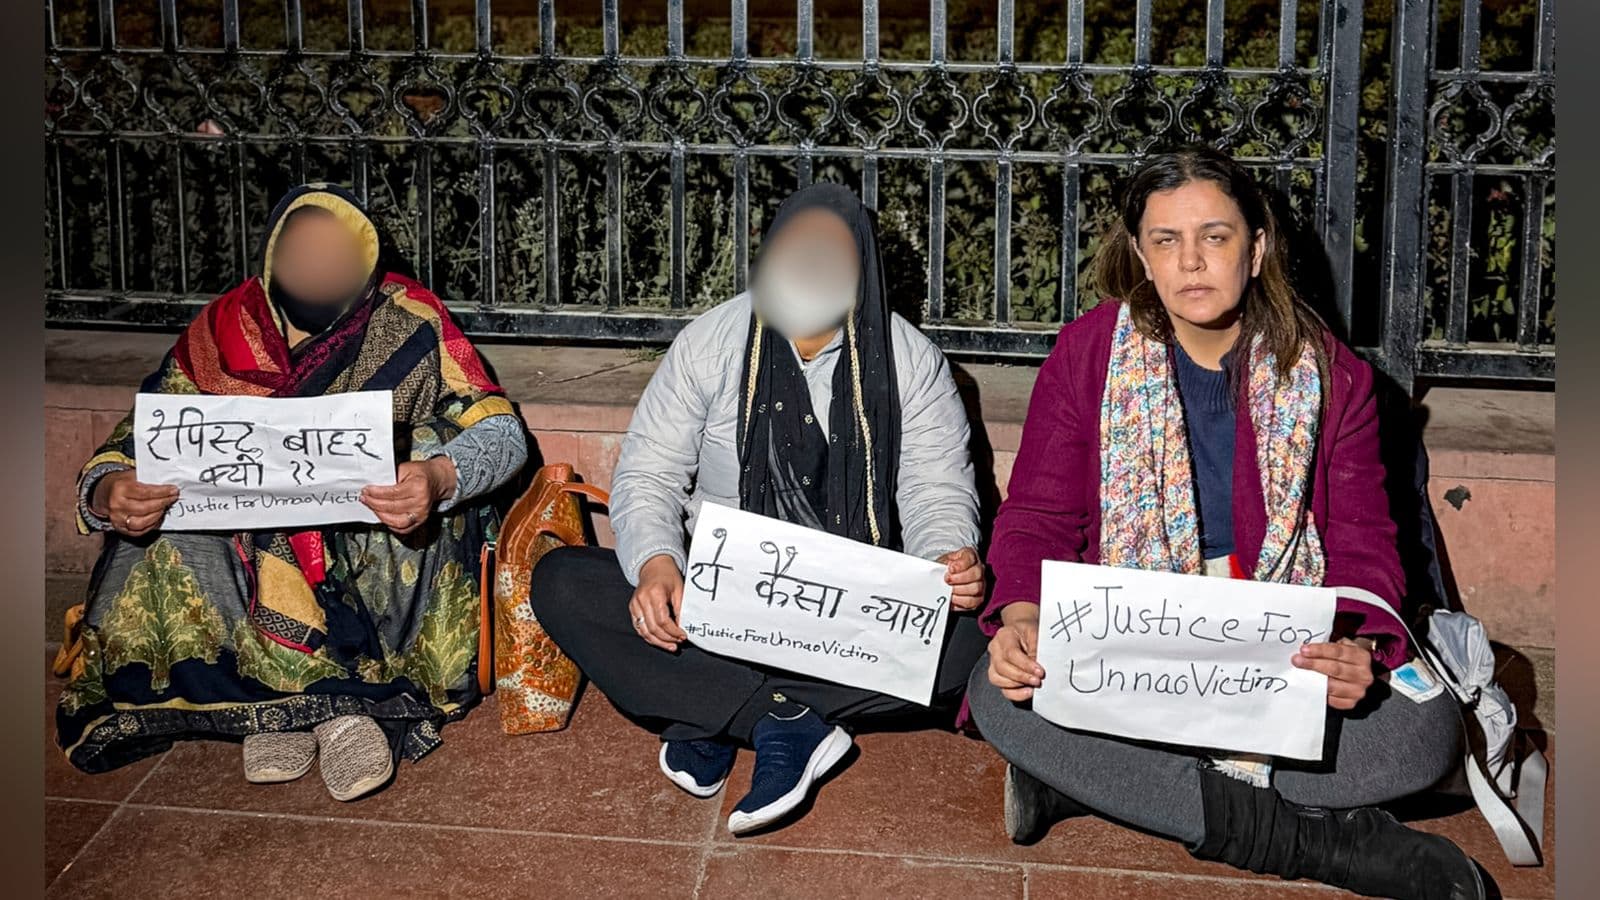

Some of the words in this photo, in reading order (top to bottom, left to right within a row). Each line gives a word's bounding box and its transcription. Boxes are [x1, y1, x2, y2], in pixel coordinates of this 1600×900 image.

[283, 428, 382, 460] बाहर
[691, 528, 733, 601] ये
[756, 541, 848, 618] कैसा
